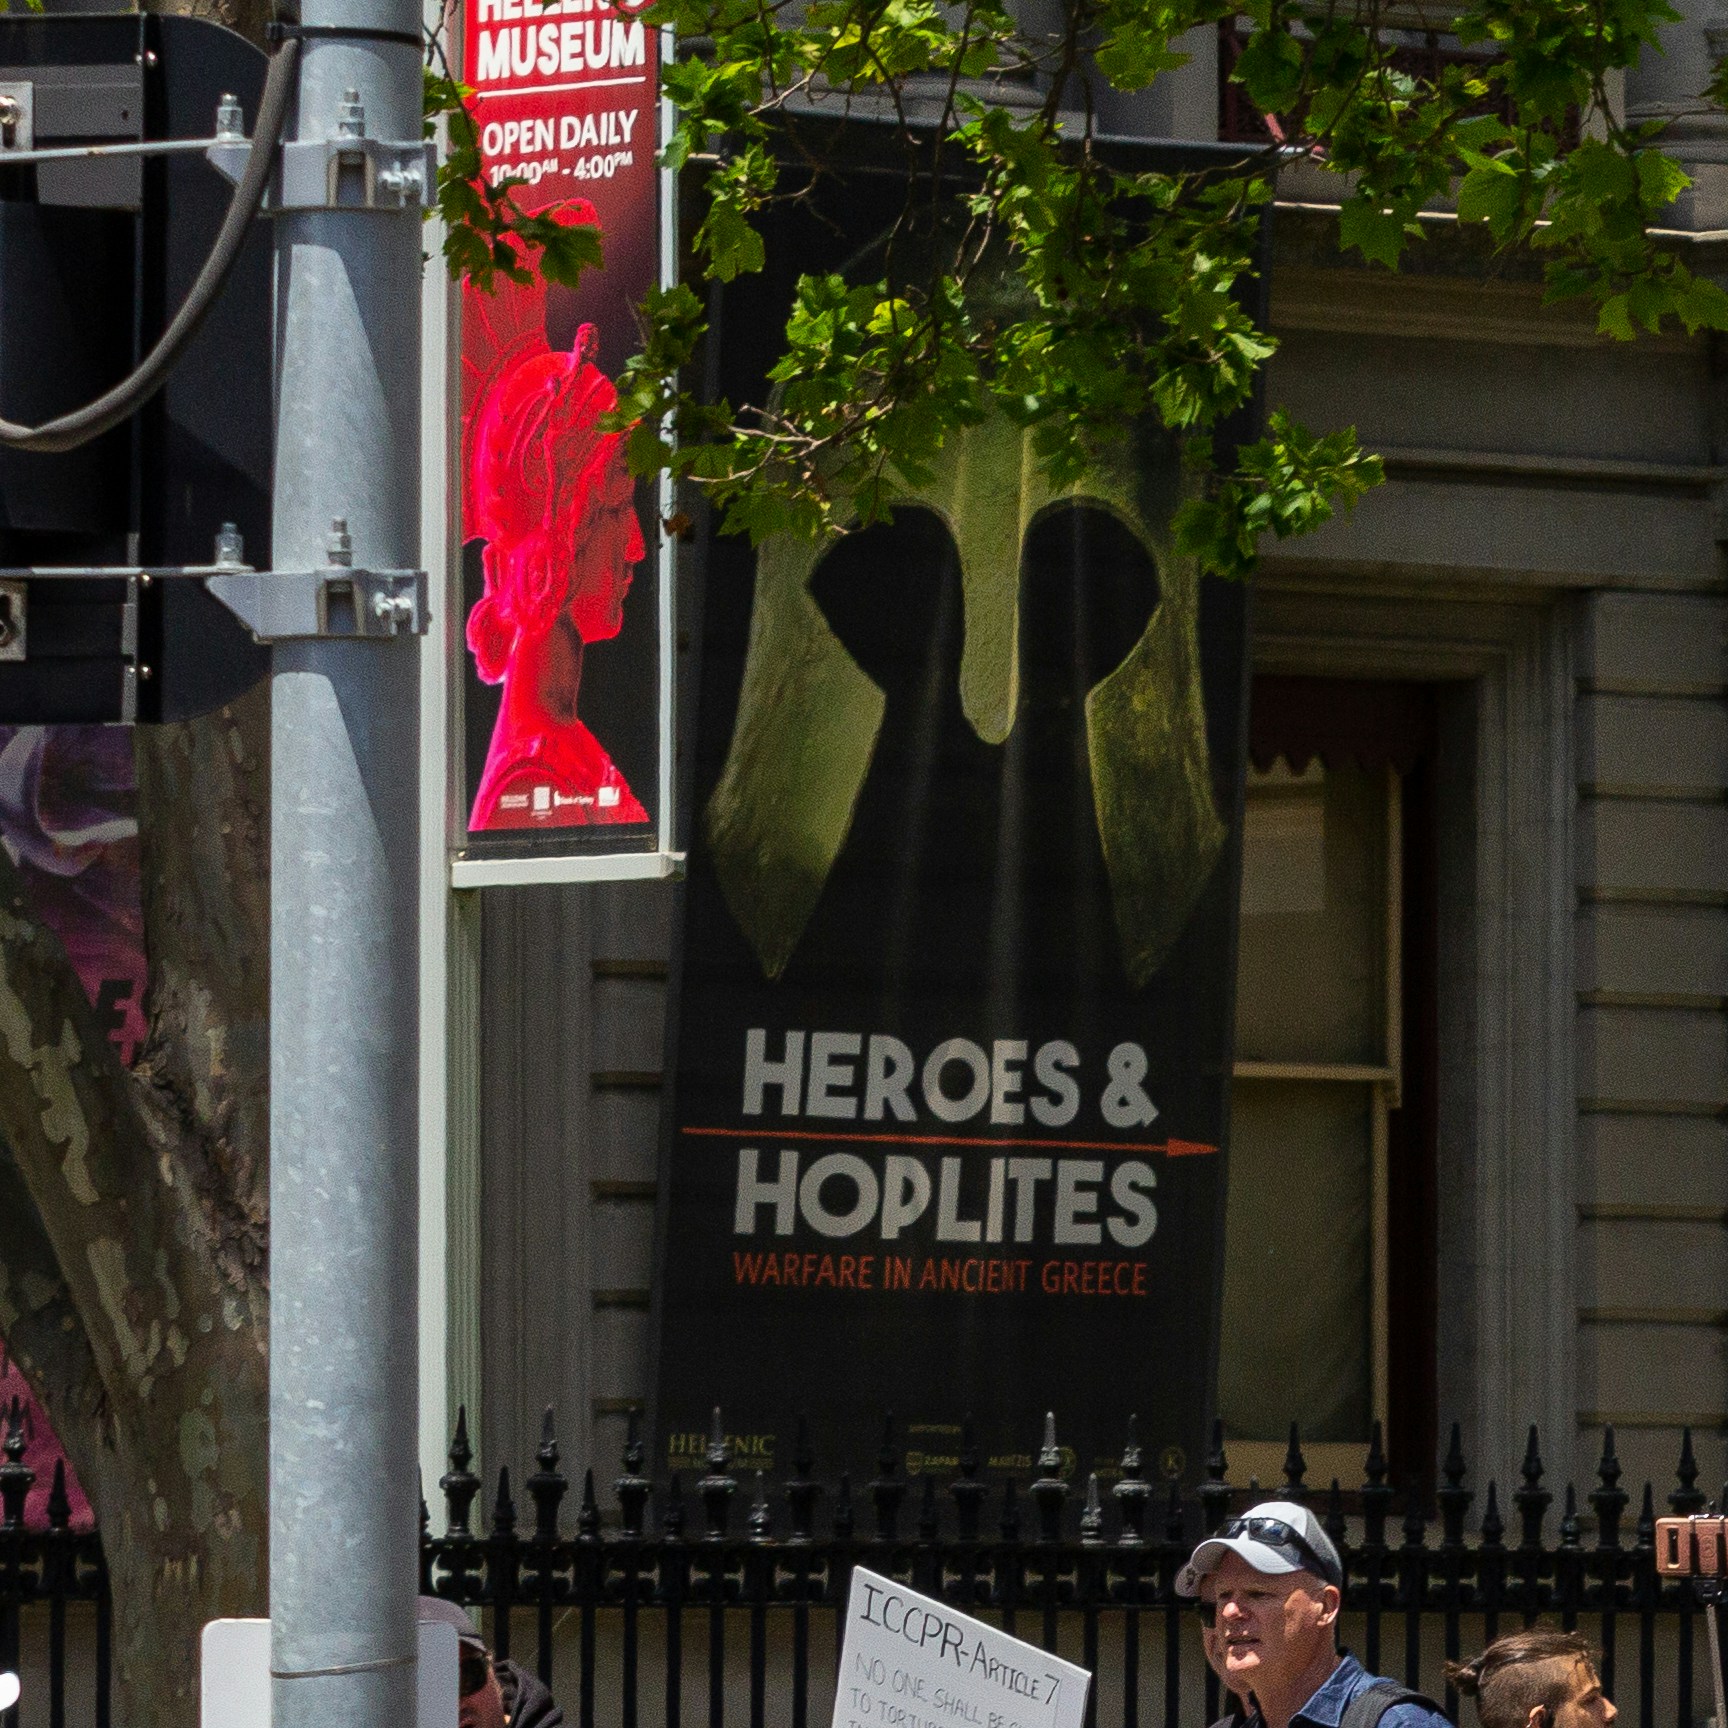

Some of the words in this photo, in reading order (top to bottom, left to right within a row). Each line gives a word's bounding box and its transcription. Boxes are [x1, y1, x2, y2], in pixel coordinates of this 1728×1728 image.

[477, 19, 646, 82] MUSEUM
[482, 117, 555, 157] OPEN
[560, 108, 639, 150] DAILY
[742, 1028, 1081, 1128] HEROES
[1100, 1041, 1160, 1128] &
[733, 1147, 1159, 1249] HOPLITES
[732, 1251, 875, 1291] WARFARE
[883, 1256, 912, 1291] IN
[918, 1258, 1033, 1294] ANCIENT
[1040, 1260, 1149, 1297] GREECE
[669, 1433, 777, 1455] HELENIC
[850, 1687, 871, 1714] TO
[856, 1653, 886, 1685] NO
[892, 1669, 928, 1702] ONE
[933, 1688, 982, 1725] SHALL
[1044, 1674, 1061, 1705] 7
